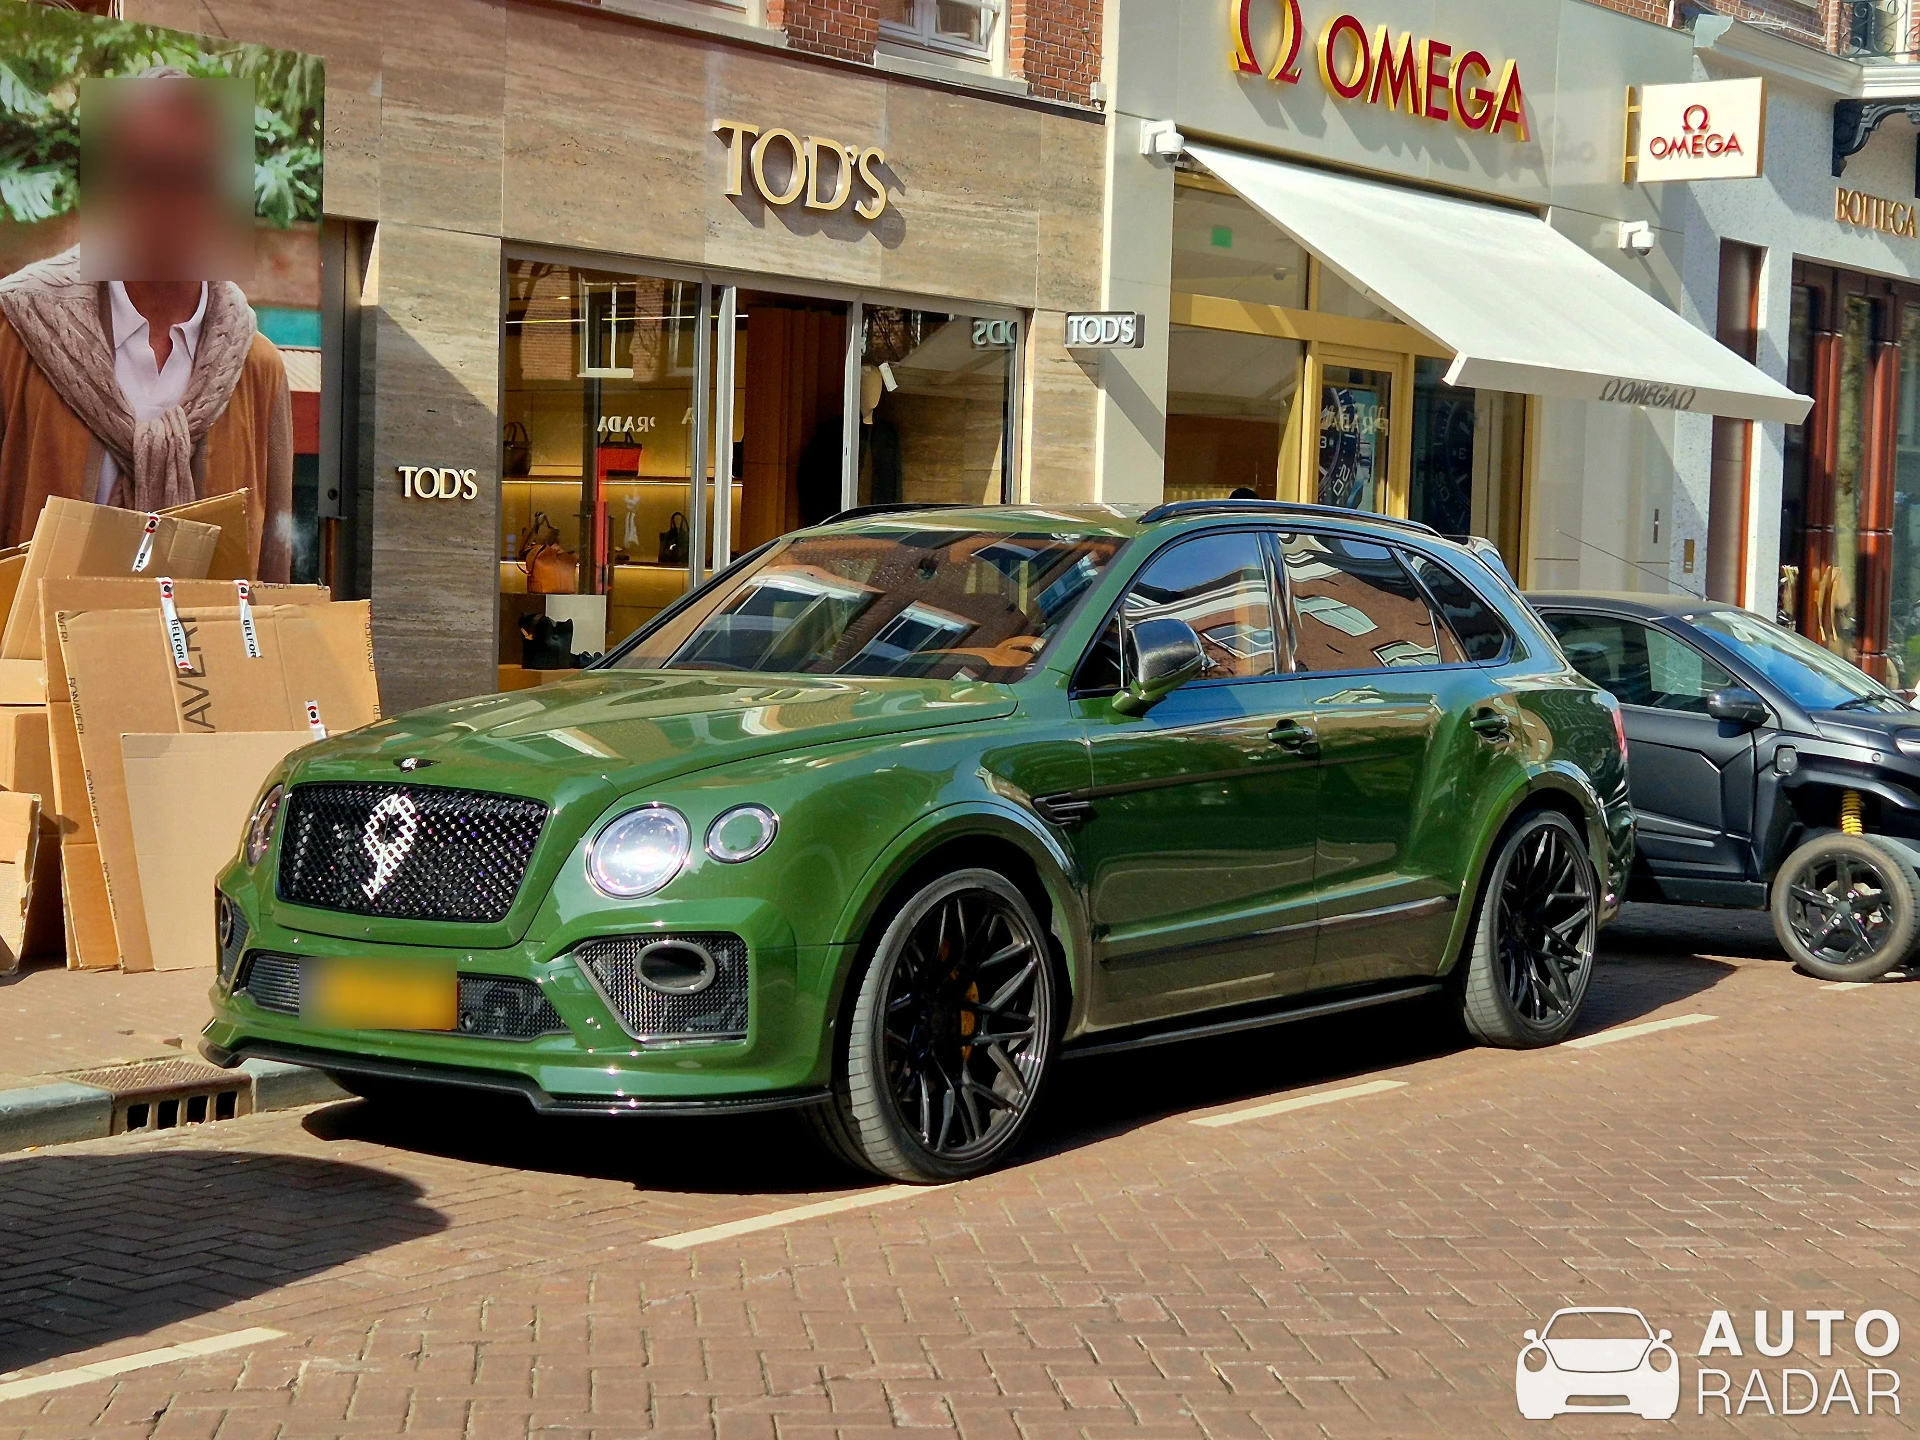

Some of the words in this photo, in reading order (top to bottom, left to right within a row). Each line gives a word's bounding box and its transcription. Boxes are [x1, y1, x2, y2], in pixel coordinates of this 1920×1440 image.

[1318, 14, 1530, 142] OMEGA
[1650, 133, 1743, 158] OMEGA
[712, 118, 887, 220] TOD'S
[1834, 187, 1918, 239] BOTTEGA
[1067, 315, 1135, 344] TOD'S
[398, 465, 478, 500] TOD'S
[170, 618, 186, 660] BELFOR
